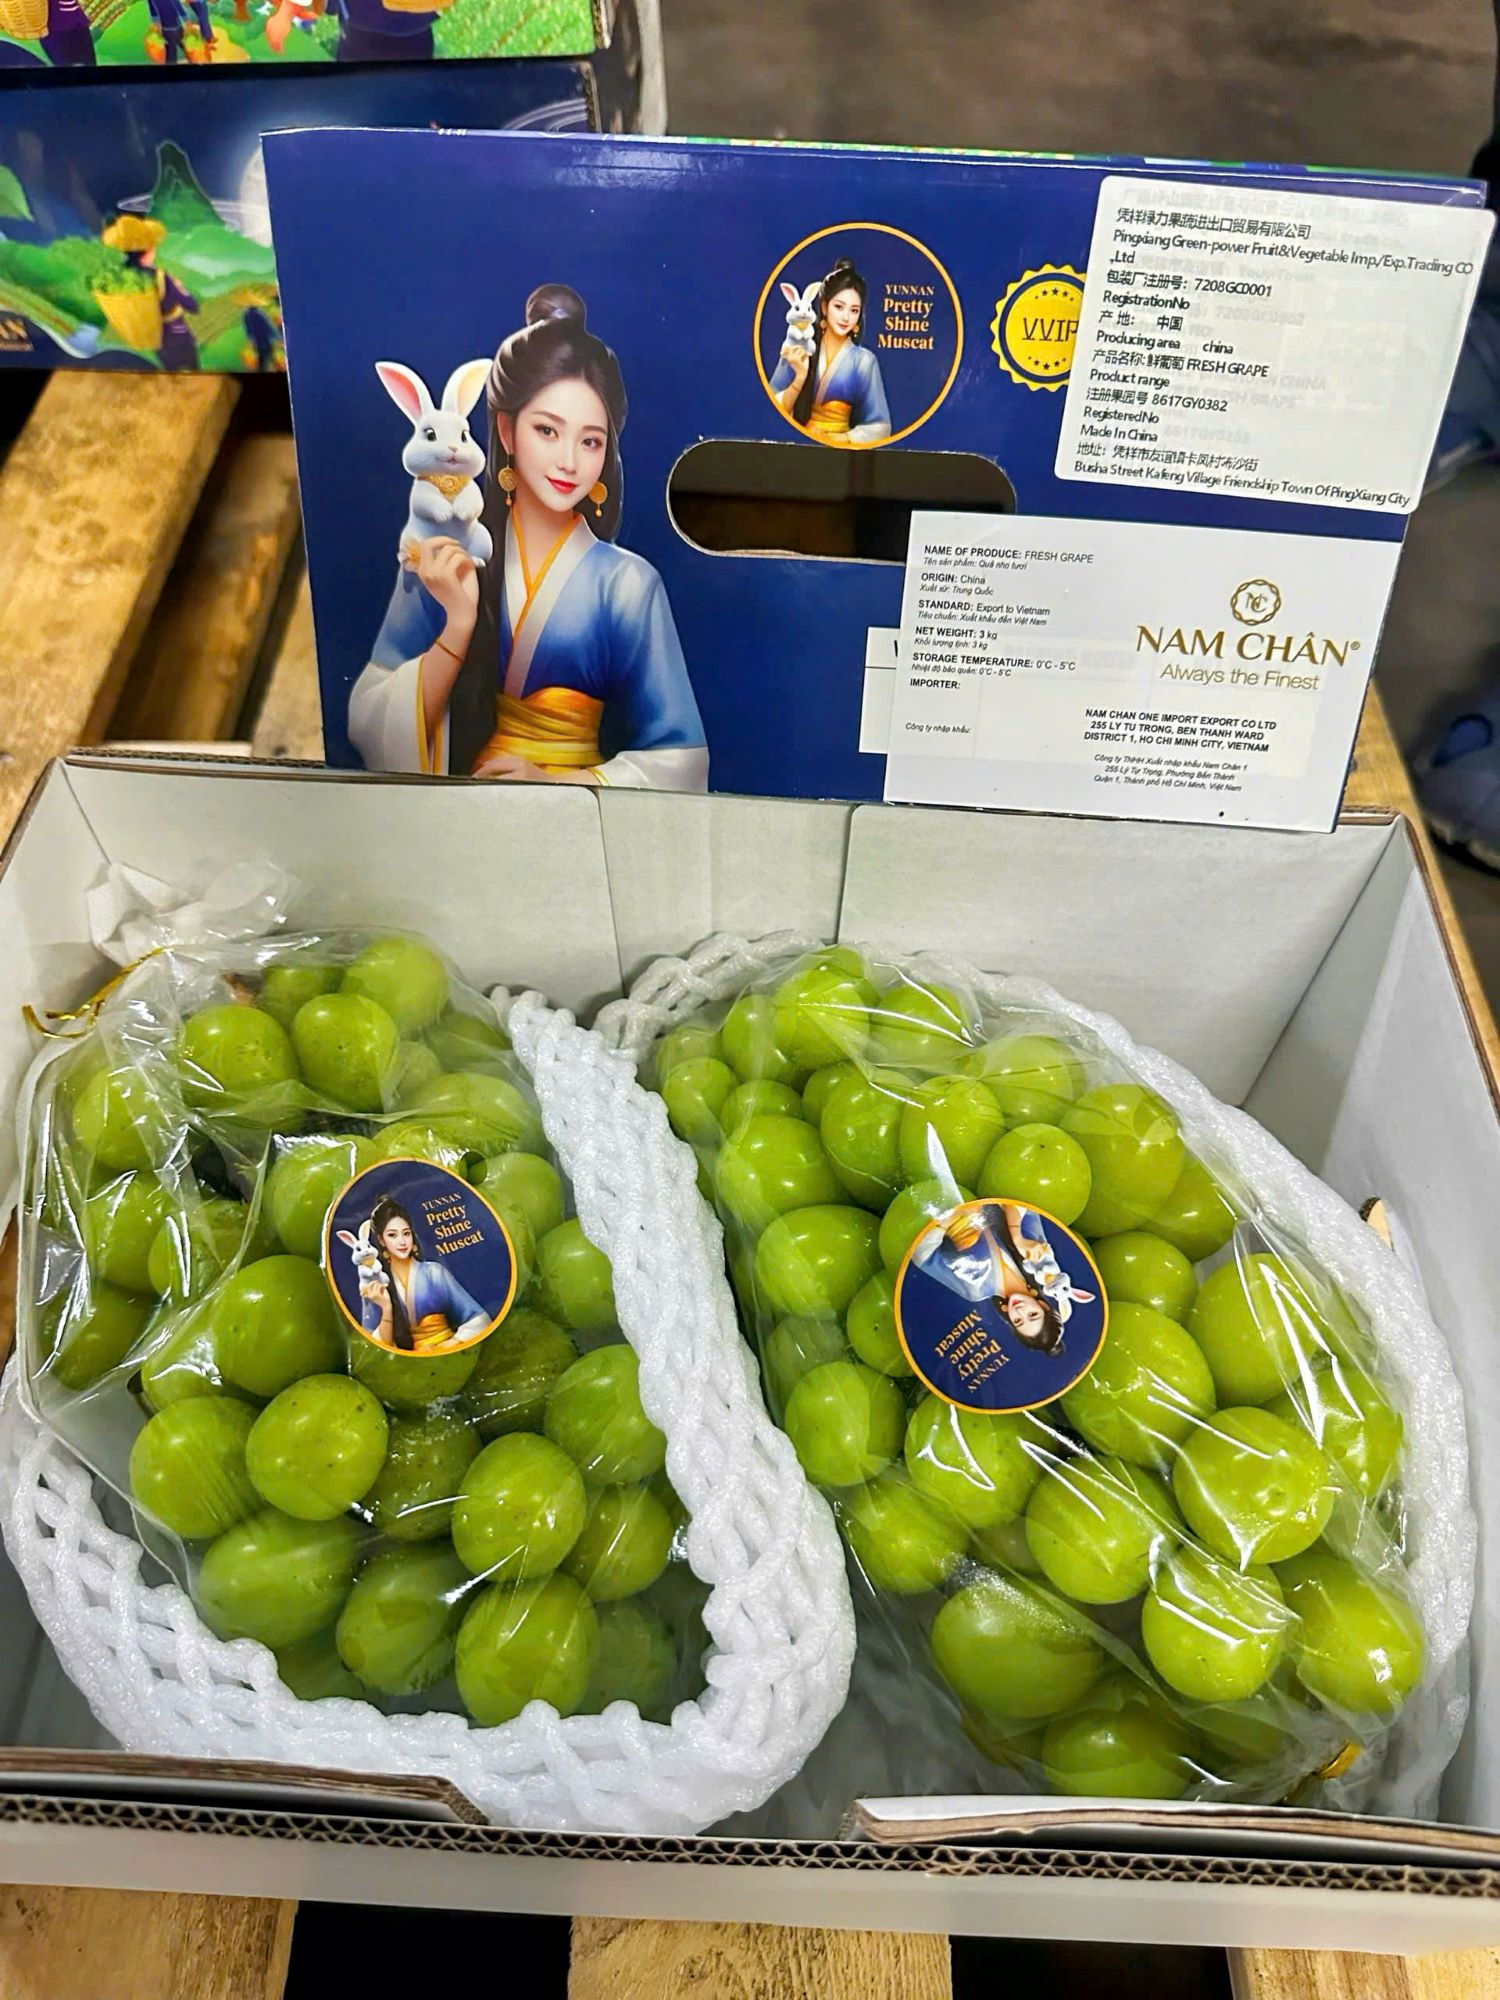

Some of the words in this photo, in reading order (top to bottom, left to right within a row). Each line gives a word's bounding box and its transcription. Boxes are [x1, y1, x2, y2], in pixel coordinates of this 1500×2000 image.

[1113, 229, 1170, 250] Pingxiang
[1172, 235, 1250, 255] Green-power
[1455, 261, 1473, 274] CO
[885, 284, 935, 296] YUNNAN
[883, 298, 933, 319] Pretty
[885, 315, 929, 332] Shine
[1022, 317, 1079, 342] VVIP
[1156, 315, 1184, 331] 中国
[877, 334, 934, 350] Muscat
[1096, 330, 1156, 349] Producing
[1157, 338, 1180, 349] area
[1202, 340, 1234, 355] china
[1186, 358, 1226, 373] FRESH
[1227, 362, 1270, 378] GRAPE
[1090, 369, 1136, 384] Product
[1137, 375, 1170, 390] range
[1152, 394, 1228, 412] 8617GY0382
[1080, 424, 1112, 438] Made
[1114, 428, 1126, 439] In
[1128, 429, 1158, 442] China
[1074, 461, 1108, 475] Busha
[1110, 463, 1144, 478] Street
[1146, 467, 1185, 485] Kafeng
[1186, 471, 1222, 488] Village
[1223, 475, 1279, 494] Friendship
[1281, 481, 1313, 495] Town
[1388, 493, 1411, 508] City
[924, 545, 952, 556] NAME
[955, 547, 968, 557] OF
[970, 548, 1022, 559] PRODUCE:
[1024, 551, 1058, 562] FRESH
[1060, 553, 1094, 564] GRAPE
[924, 557, 937, 566] Tên
[921, 573, 958, 583] ORIGIN:
[960, 575, 986, 585] China
[953, 586, 972, 596] Trung
[974, 586, 994, 596] Quốc
[918, 600, 974, 611] STANDARD:
[976, 603, 1004, 614] Export
[1005, 605, 1014, 614] to
[1016, 605, 1050, 616] Vietnam
[1014, 616, 1028, 625] Việt
[1029, 618, 1047, 626] Nam
[915, 627, 934, 636] NET
[936, 627, 977, 638] WEIGHT:
[979, 631, 985, 639] 3
[987, 631, 997, 641] kg
[1136, 625, 1225, 659] NAM
[978, 641, 988, 650] kg
[912, 653, 958, 663] STORAGE
[960, 655, 1034, 669] TEMPERATURE:
[910, 678, 961, 689] IMPORTER:
[1160, 663, 1224, 685] Always
[1230, 669, 1259, 685] the
[1264, 671, 1320, 690] Finest
[905, 722, 924, 732] Công
[925, 724, 933, 732] ty
[1085, 709, 1107, 718] NAM
[1109, 710, 1136, 720] CHAN
[1138, 712, 1159, 721] ONE
[1161, 713, 1198, 724] IMPORT
[1200, 717, 1239, 727] EXPORT
[1241, 719, 1256, 728] CO
[1258, 720, 1277, 730] LTD
[1090, 720, 1106, 729] 255
[1109, 721, 1122, 730] LY
[1124, 722, 1136, 731] TU
[1138, 723, 1174, 735] TRONG,
[1177, 726, 1196, 735] BEN
[1199, 727, 1231, 738] THANH
[1234, 730, 1264, 740] WARD
[1084, 732, 1126, 742] DISTRICT
[1129, 735, 1137, 744] 1,
[1139, 735, 1153, 744] HO
[1156, 736, 1172, 745] CHI
[1174, 738, 1198, 747] MINH
[1200, 739, 1225, 750] CITY,
[1227, 741, 1269, 752] VIETNAM
[1094, 753, 1113, 763] Công
[1115, 755, 1122, 764] ty
[1202, 761, 1219, 769] Nam
[1105, 765, 1118, 773] 255
[422, 1192, 462, 1211] YUNNAN
[425, 1203, 467, 1226] Pretty
[434, 1219, 472, 1240] Shine
[435, 1231, 485, 1256] Muscat
[934, 1309, 983, 1357] Muscat
[950, 1327, 988, 1365] Shine
[958, 1339, 1002, 1381] Pretty
[967, 1354, 1010, 1394] YUNNAN
